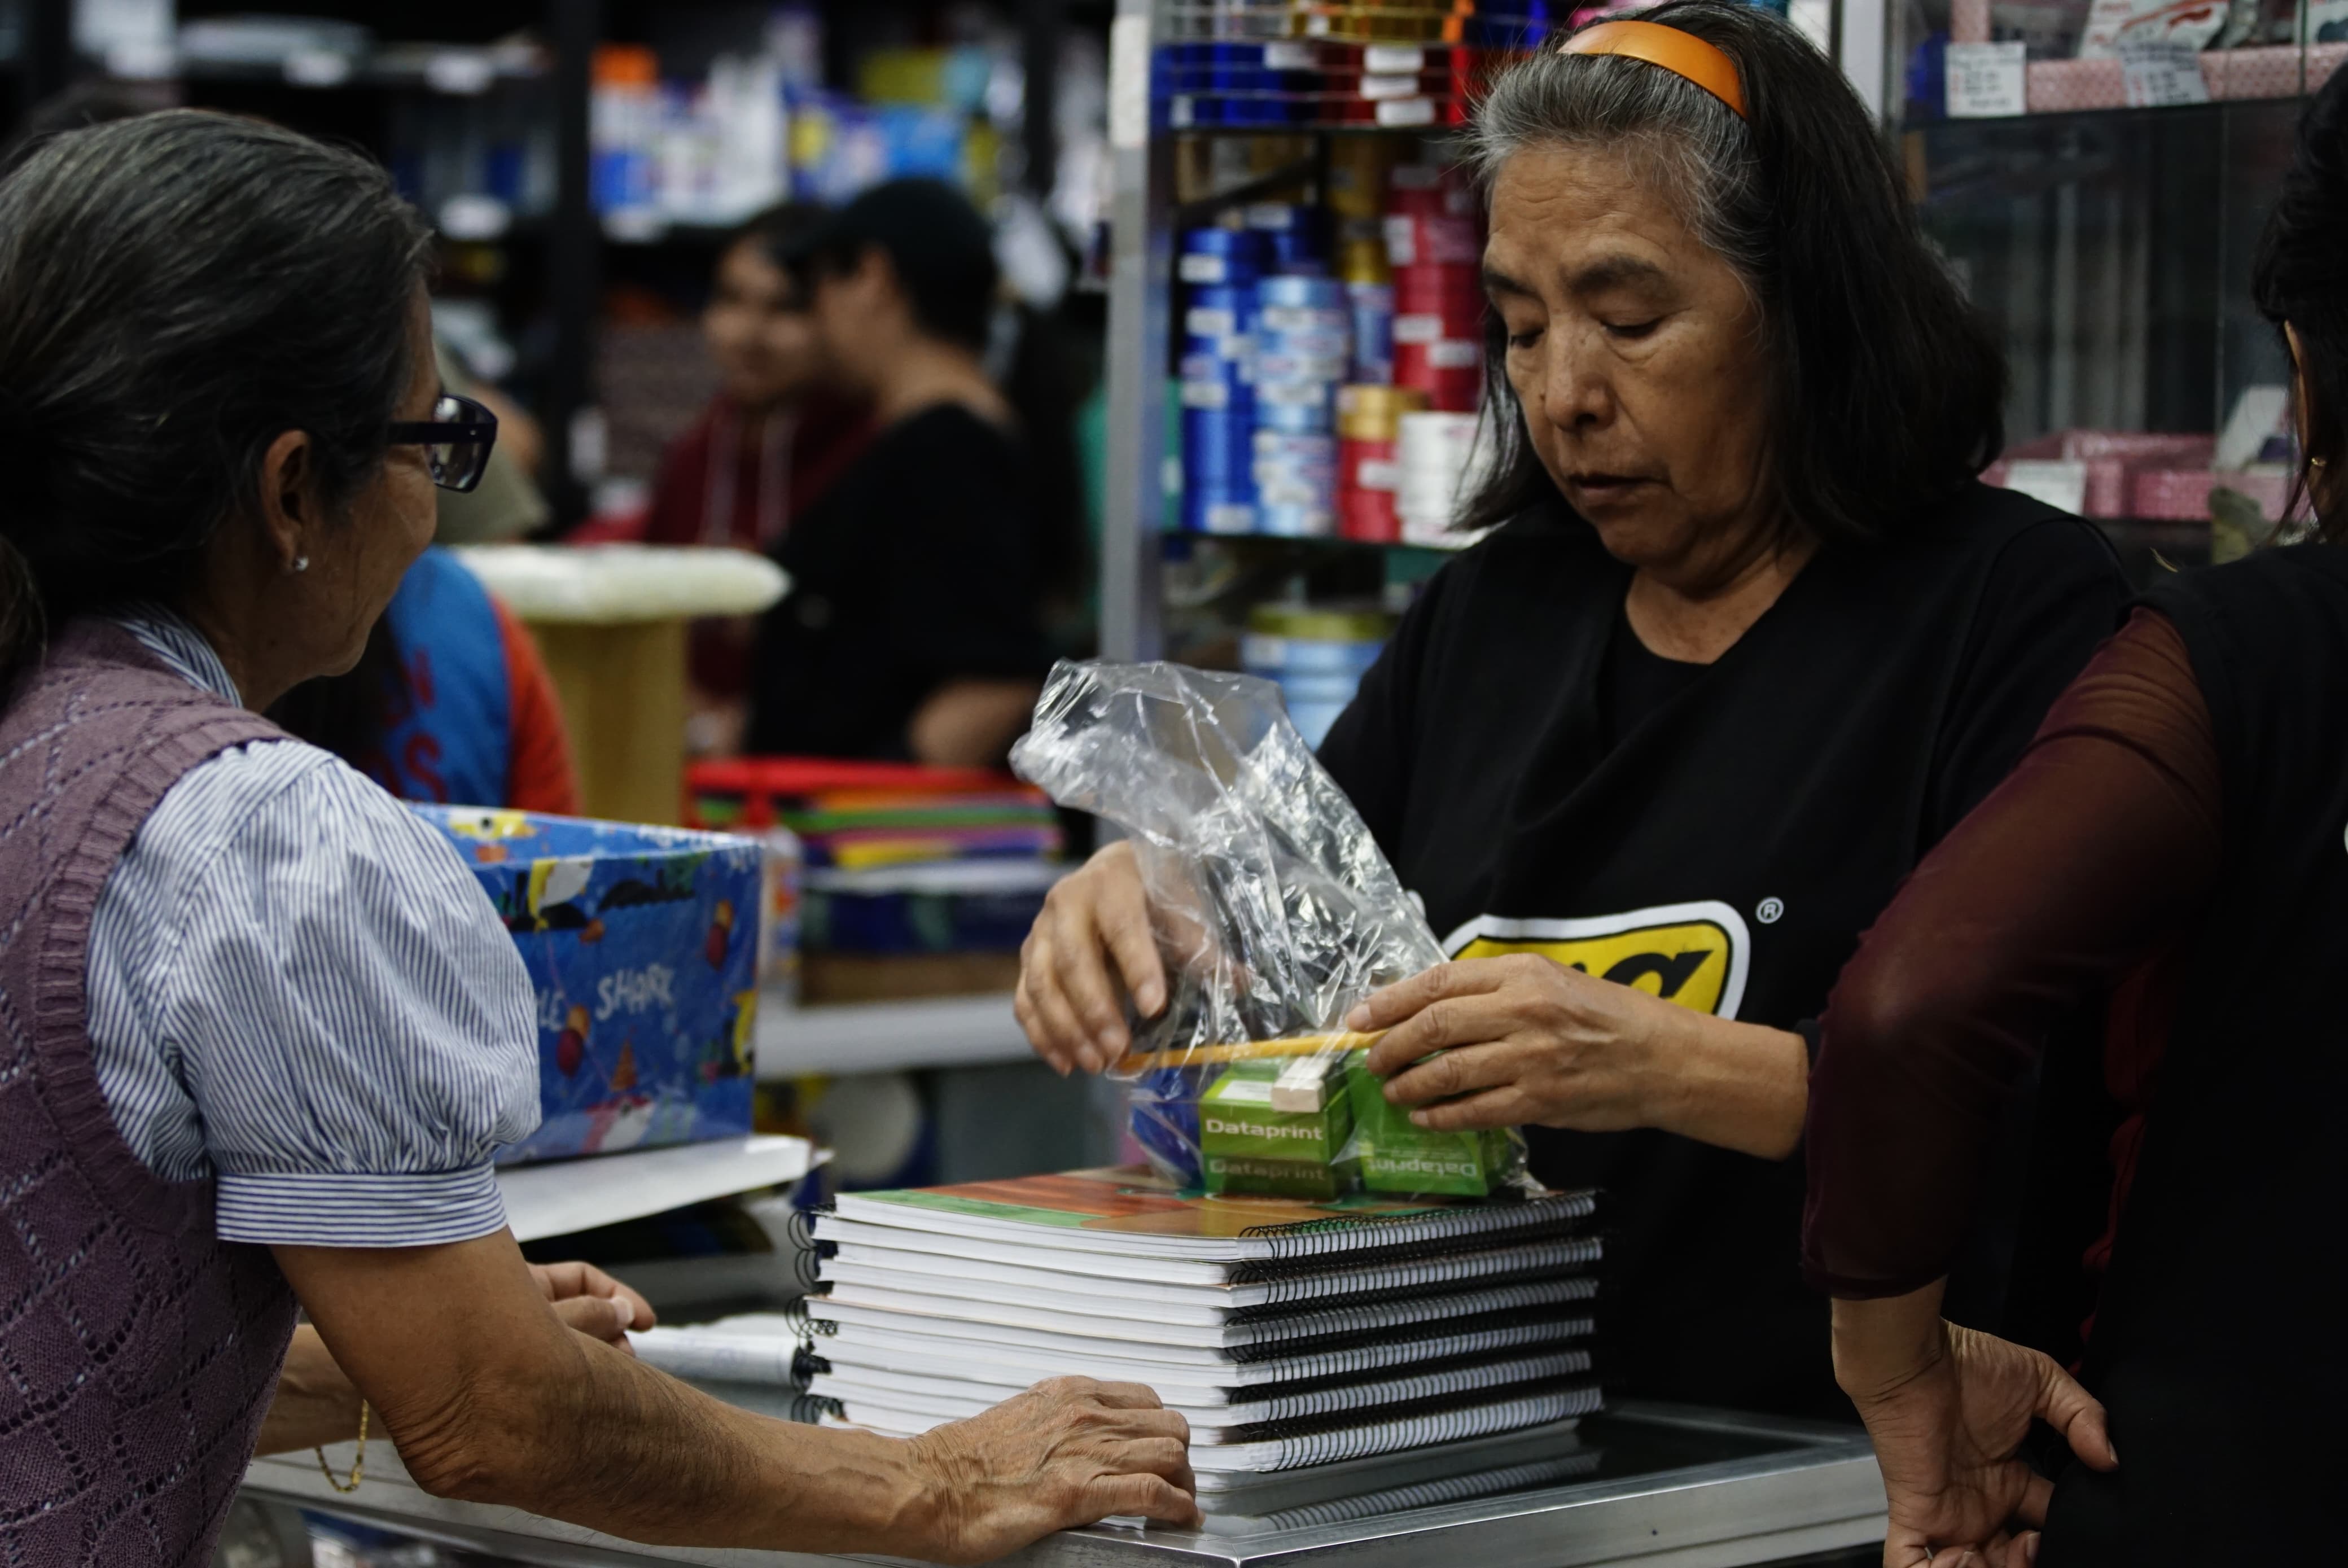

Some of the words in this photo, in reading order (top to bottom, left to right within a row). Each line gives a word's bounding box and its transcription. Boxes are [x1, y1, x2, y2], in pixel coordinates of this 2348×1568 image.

[595, 962, 677, 1021] SHARK
[1205, 1118, 1324, 1141] Dataprint
[1209, 1159, 1325, 1181] Dataprint
[1367, 1158, 1478, 1178] Dataprint
